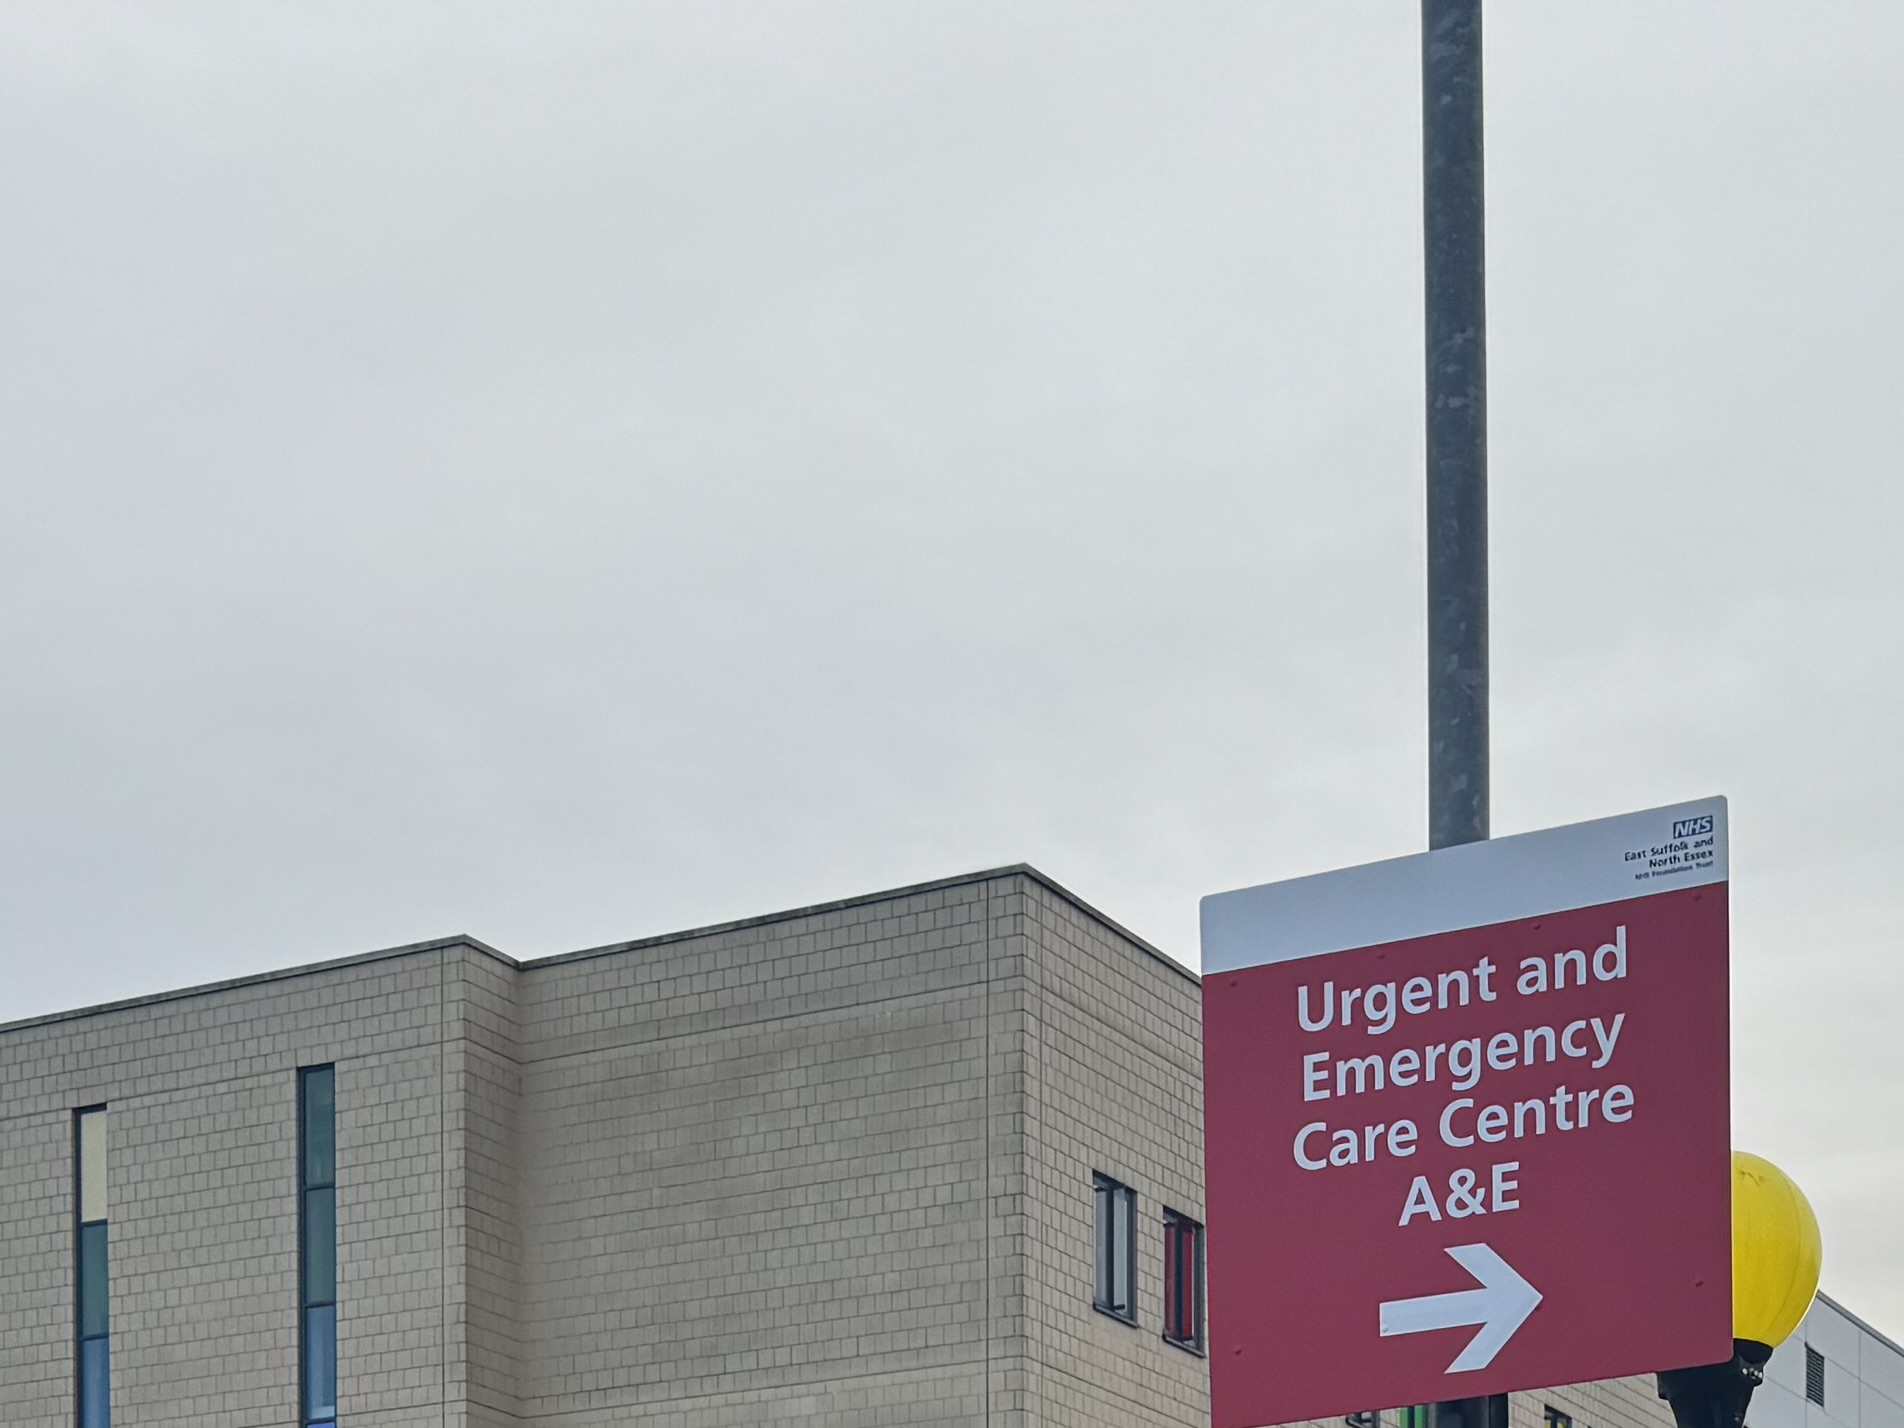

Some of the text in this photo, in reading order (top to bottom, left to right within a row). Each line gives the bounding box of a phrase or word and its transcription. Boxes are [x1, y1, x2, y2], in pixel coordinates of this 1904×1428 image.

[1625, 835, 1713, 861] East Suffolk and
[1649, 850, 1713, 868] North Essex
[1674, 816, 1712, 839] NHS
[1298, 925, 1627, 1034] Urgent and
[1303, 1013, 1625, 1101] Emergency
[1293, 1084, 1635, 1170] Care Centre
[1398, 1161, 1520, 1226] A&E
